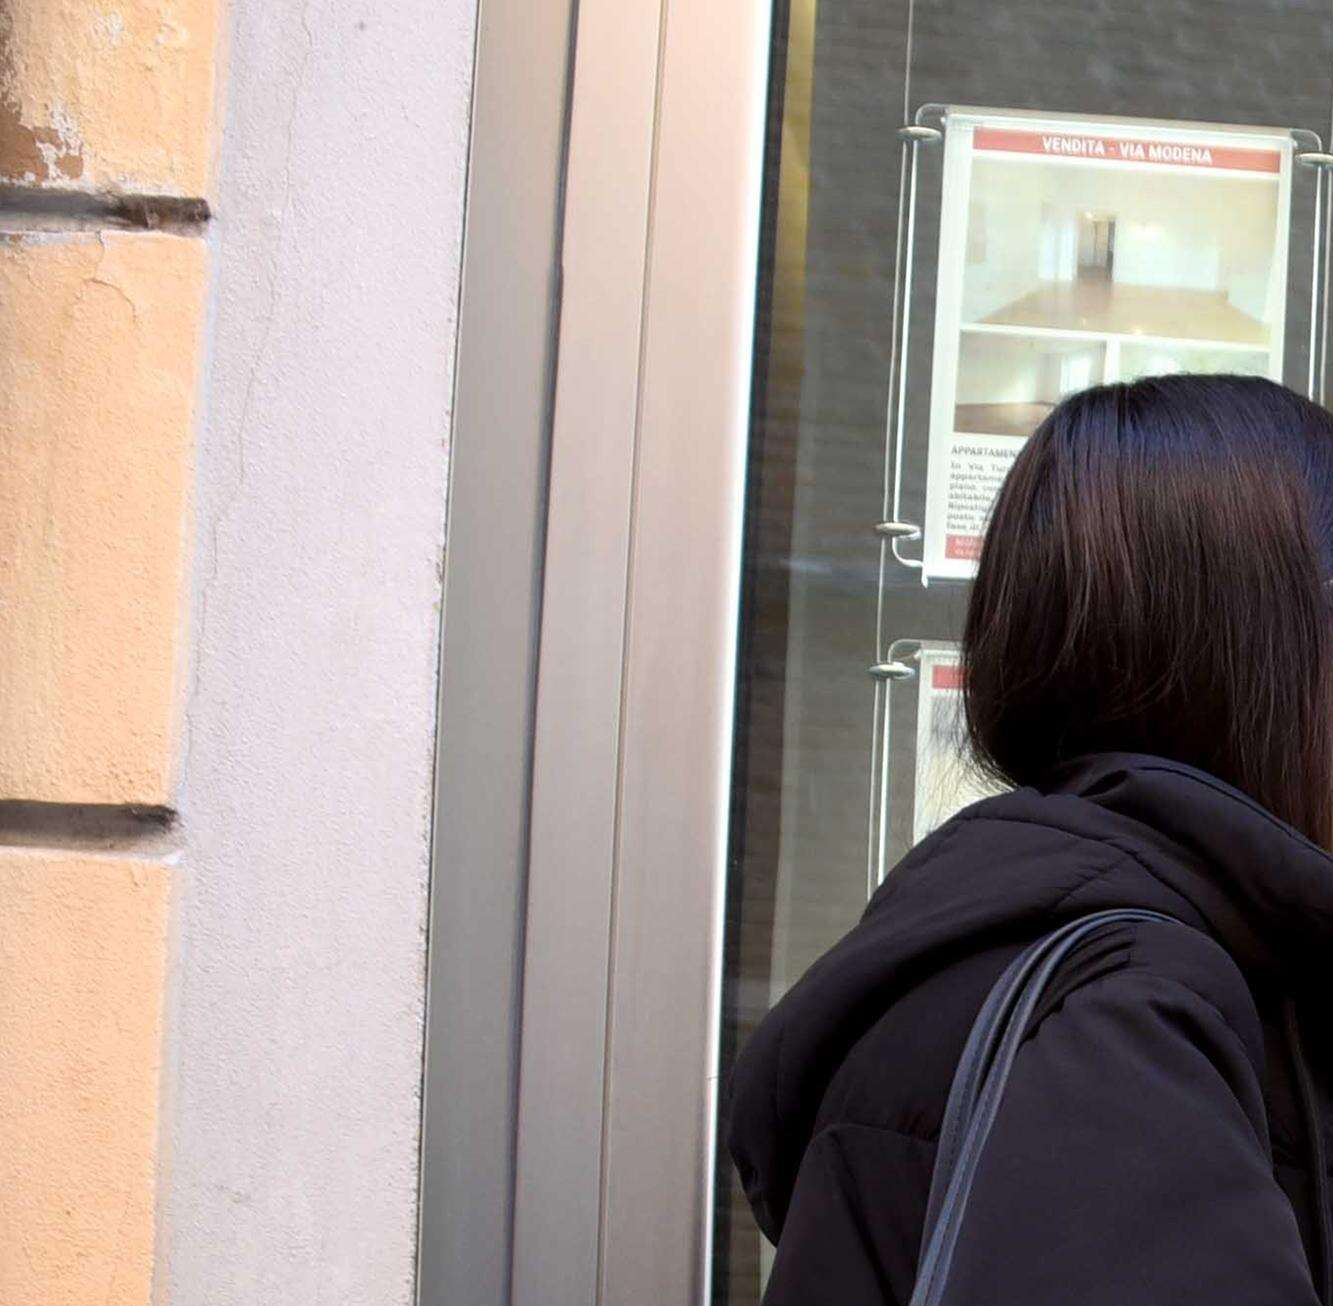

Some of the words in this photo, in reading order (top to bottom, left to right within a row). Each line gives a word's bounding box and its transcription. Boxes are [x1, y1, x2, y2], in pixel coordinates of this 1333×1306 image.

[1041, 135, 1105, 157] VENDITA
[1118, 141, 1145, 159] VIA
[1147, 143, 1213, 165] MODENA
